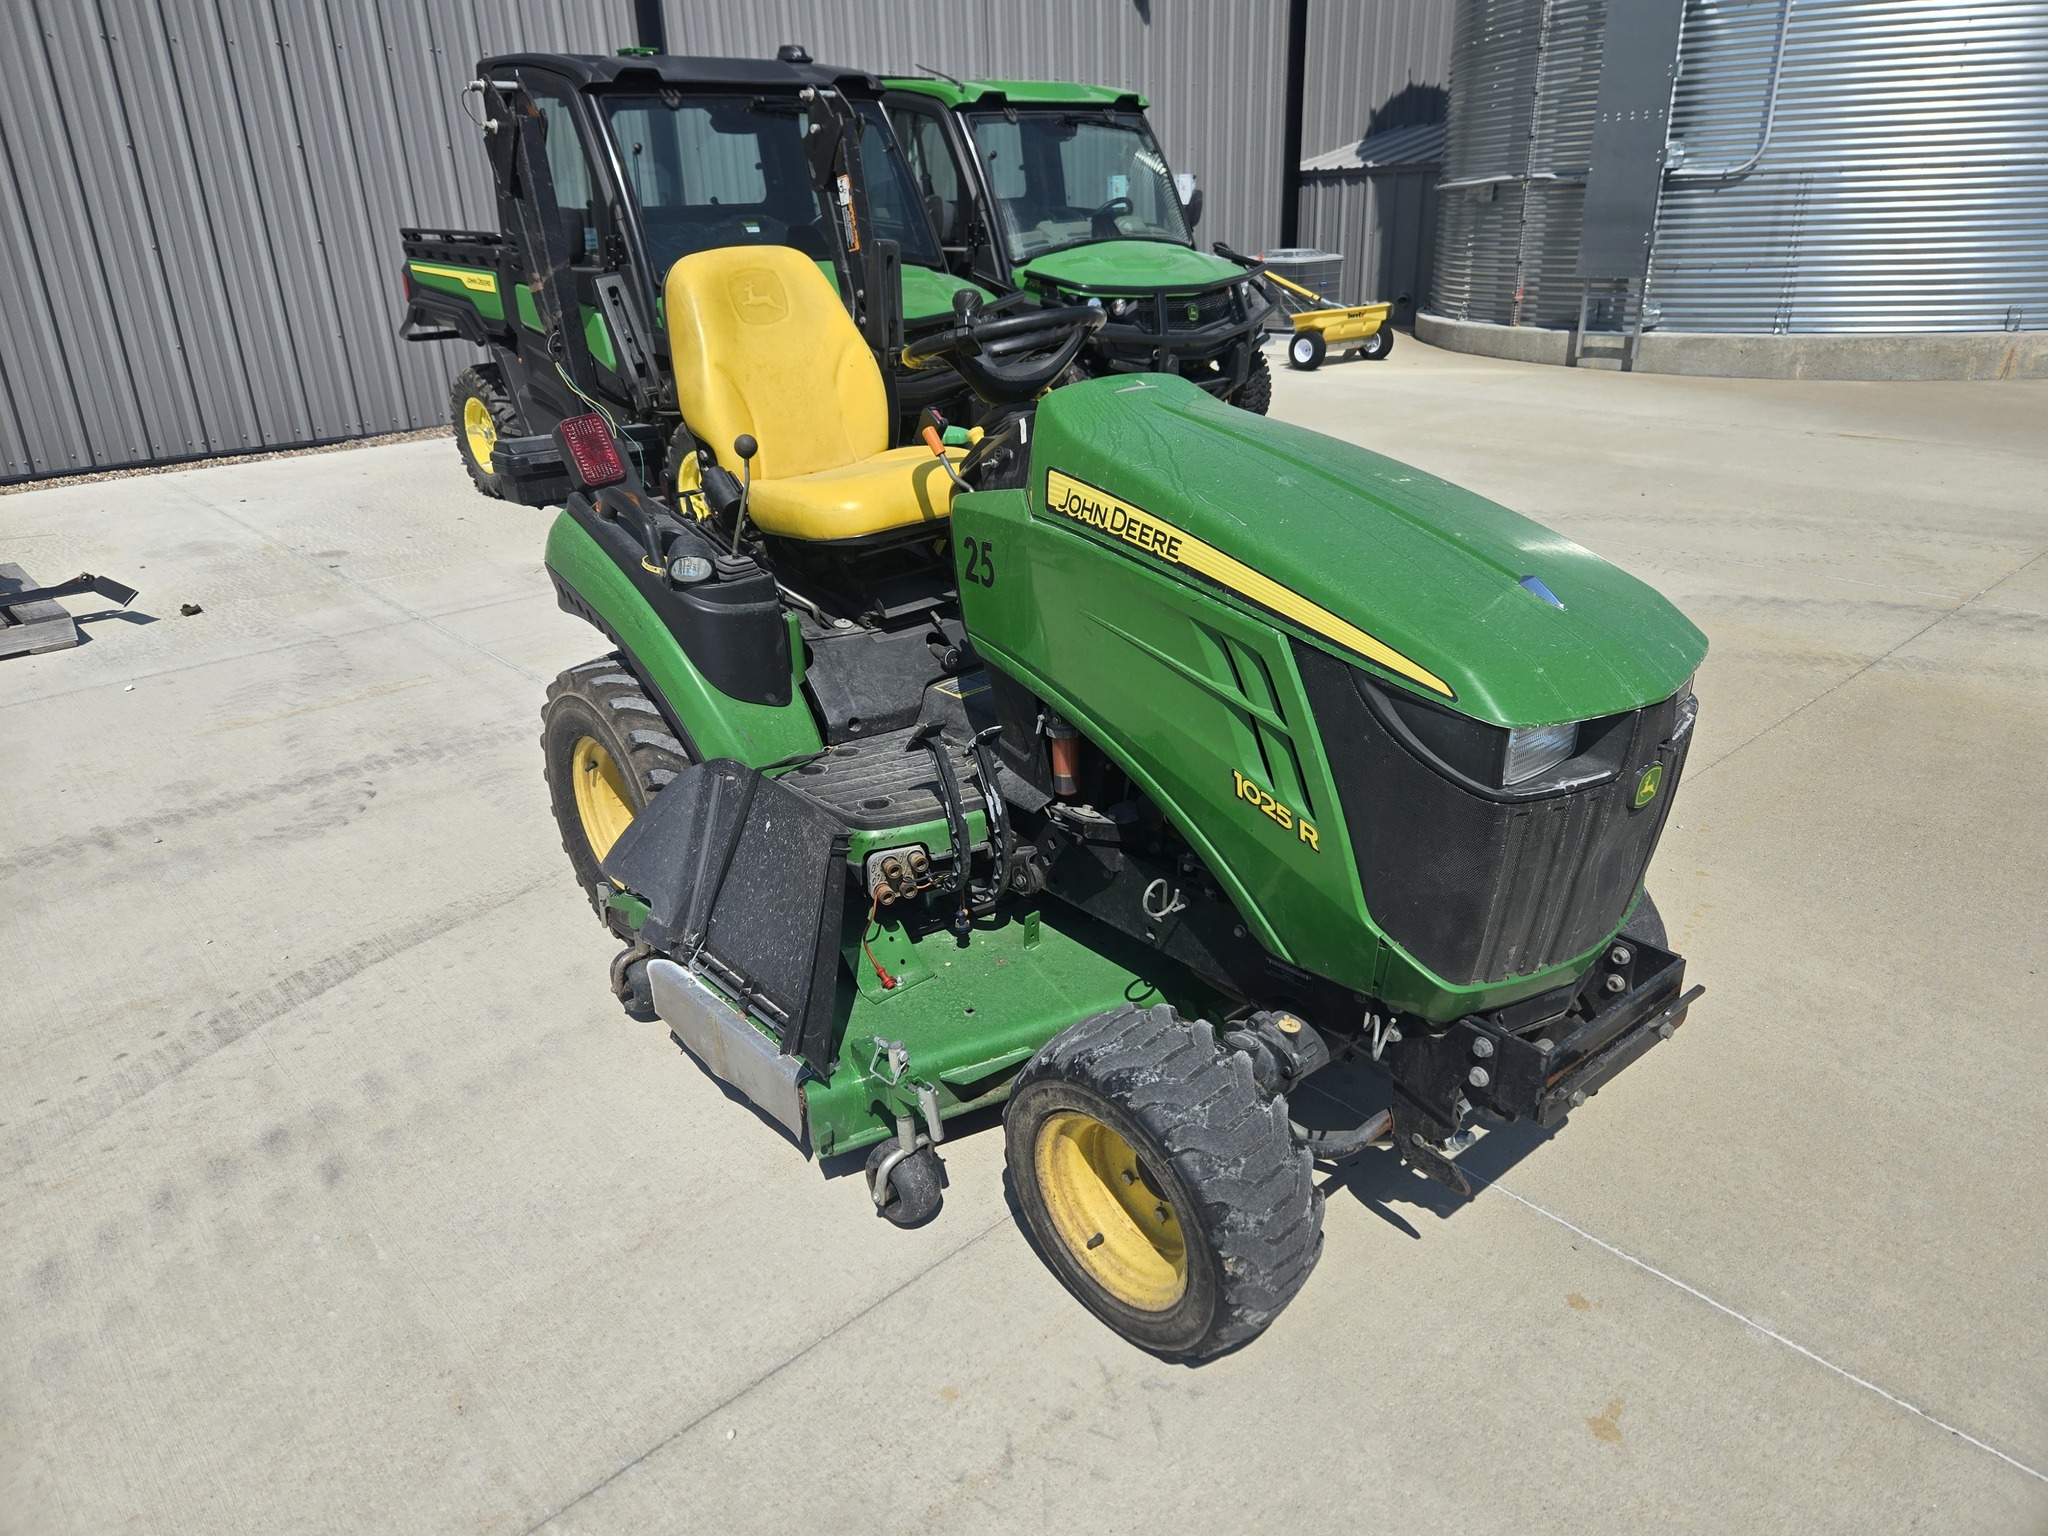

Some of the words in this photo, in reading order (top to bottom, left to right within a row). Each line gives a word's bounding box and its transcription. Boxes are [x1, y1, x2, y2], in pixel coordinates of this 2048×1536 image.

[1058, 488, 1108, 526] JOHN
[1110, 506, 1182, 560] DEERE
[963, 536, 995, 588] 25
[1232, 768, 1293, 830] 1025
[1298, 817, 1321, 853] R
